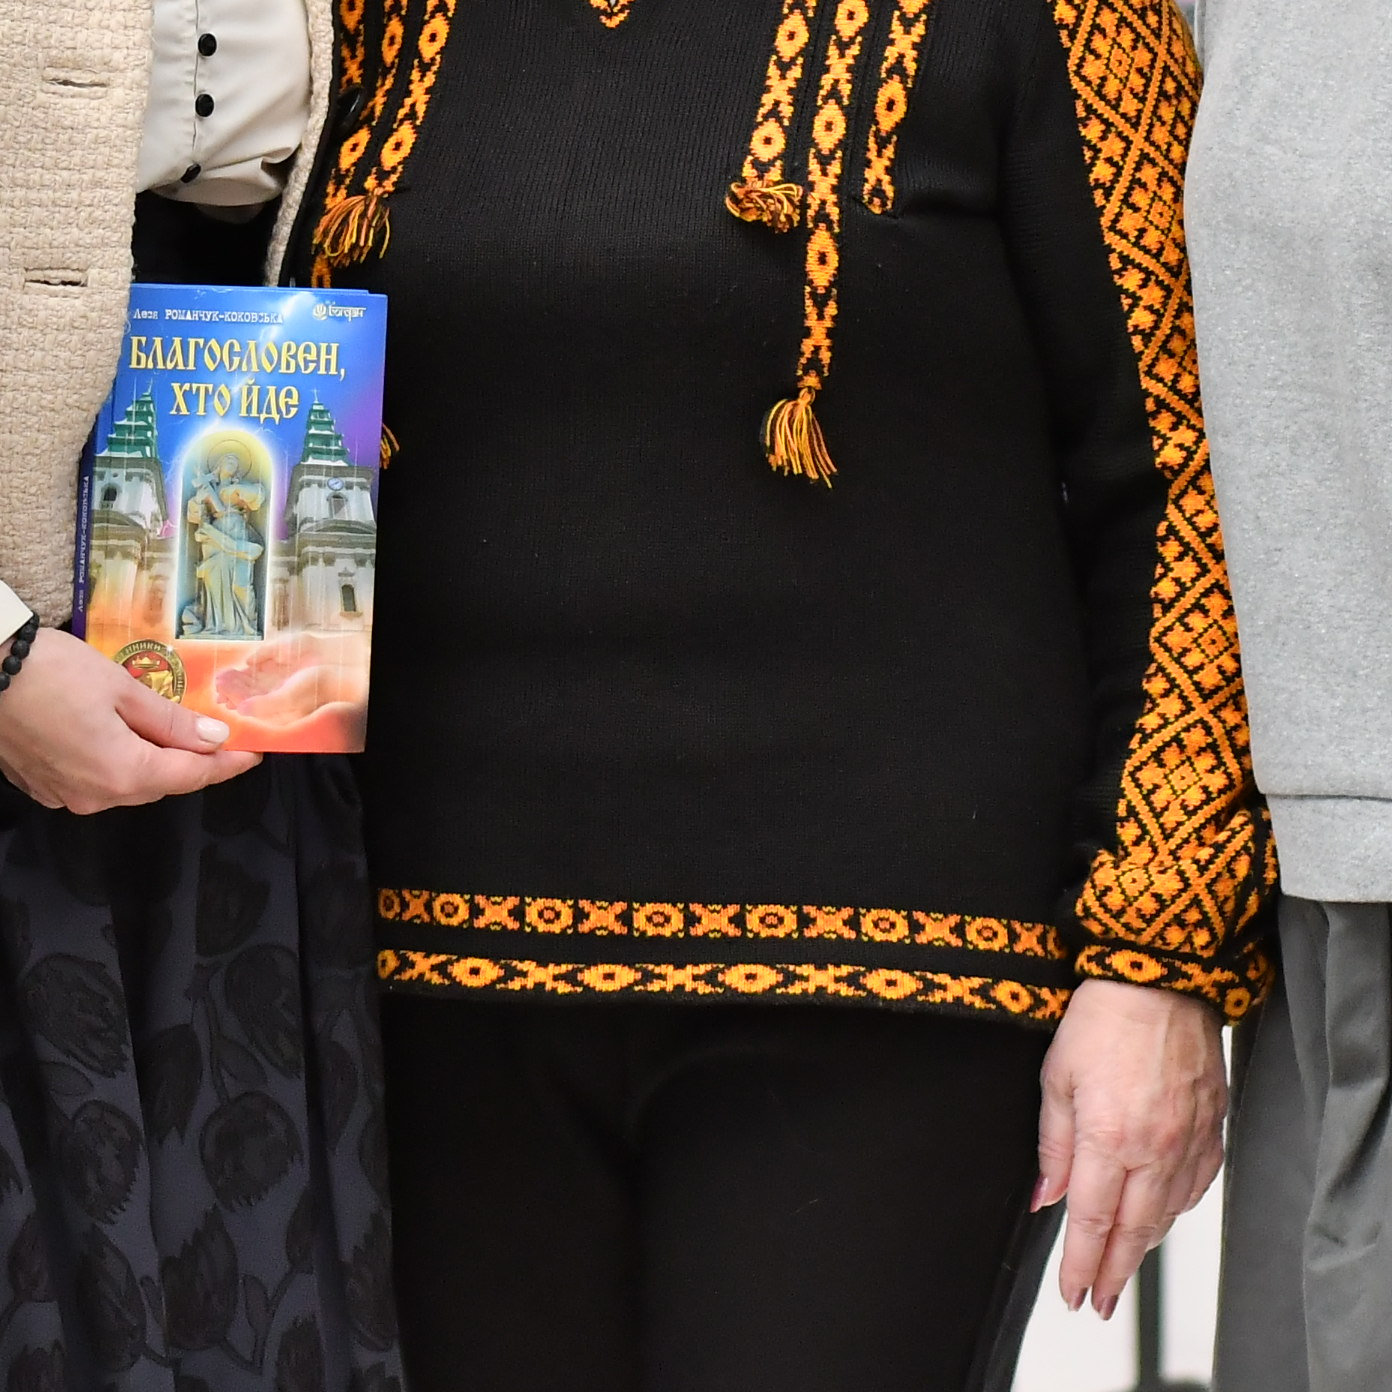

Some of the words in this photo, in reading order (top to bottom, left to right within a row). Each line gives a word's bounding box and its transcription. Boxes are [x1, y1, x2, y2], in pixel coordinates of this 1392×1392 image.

[133, 309, 158, 319] Леся
[165, 309, 283, 323] РОМАНЧУК-КОКОВСЬКА
[129, 336, 345, 381] БЛАГОСЛОВЕН,
[169, 382, 231, 416] ХТО
[239, 378, 299, 425] ЙДЕ
